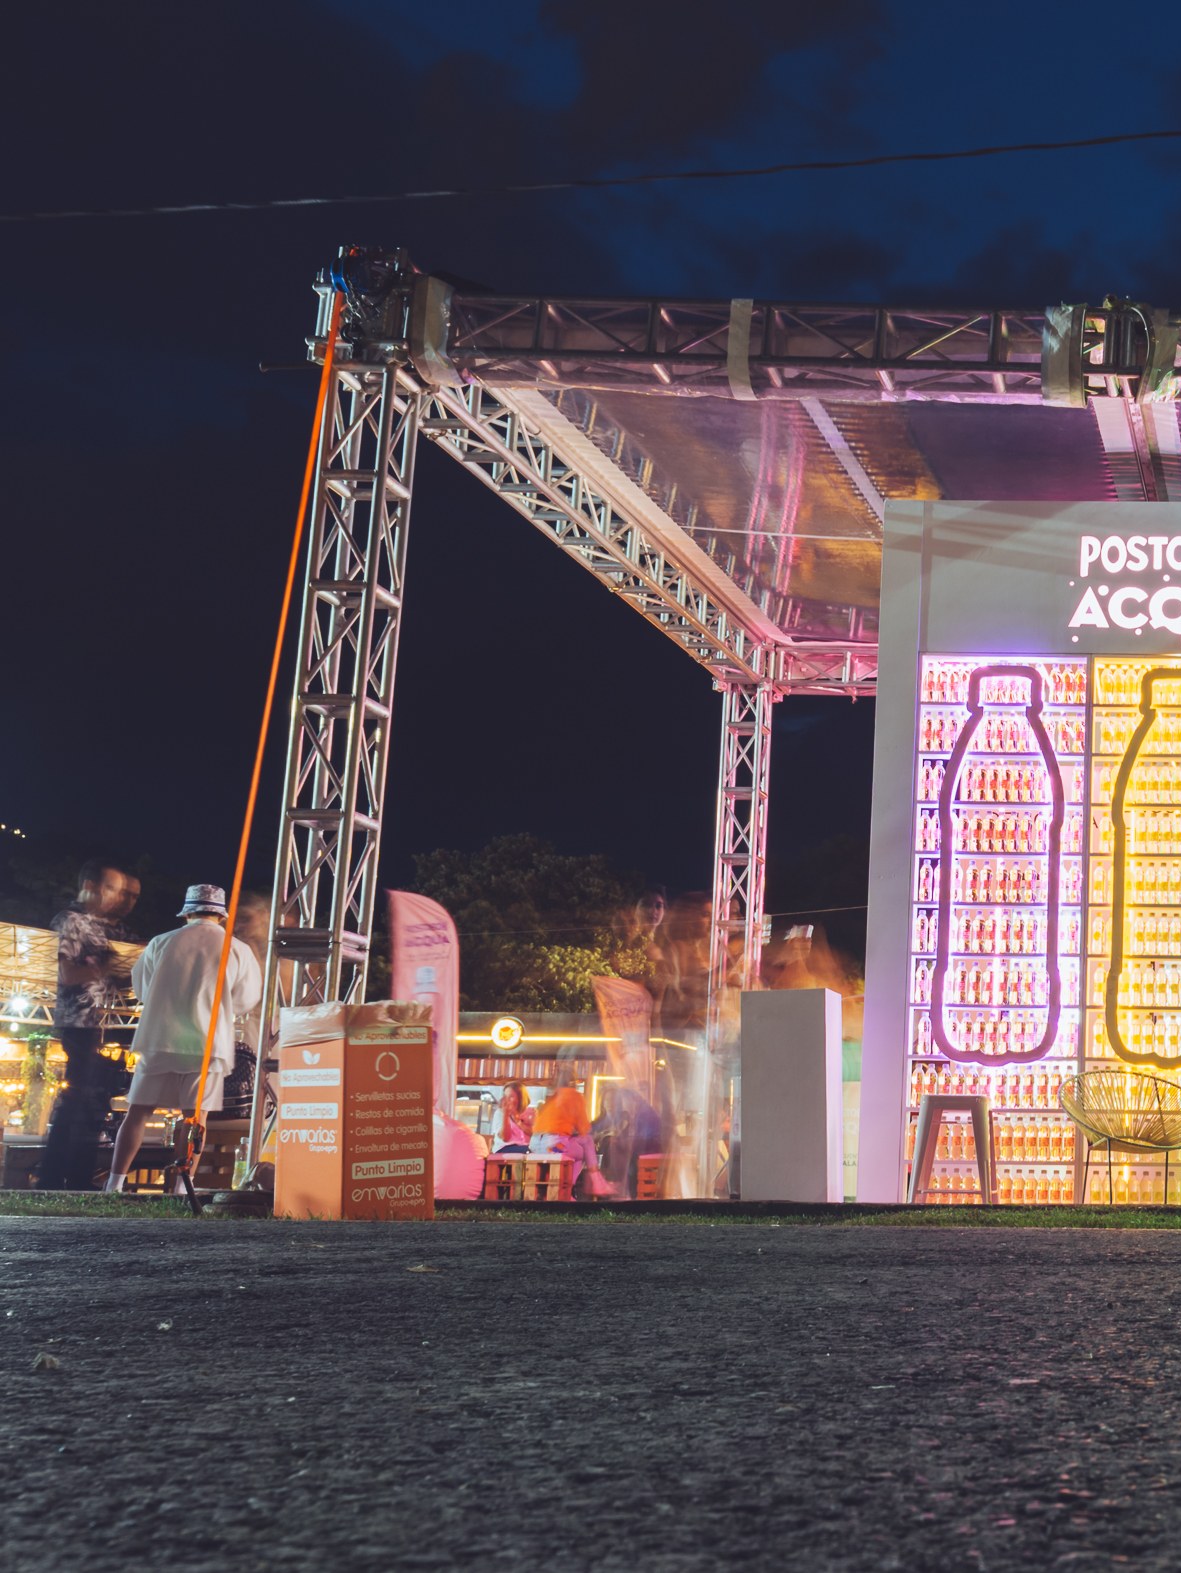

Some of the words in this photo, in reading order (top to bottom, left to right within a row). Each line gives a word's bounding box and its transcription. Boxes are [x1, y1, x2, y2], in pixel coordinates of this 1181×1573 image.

[355, 1091, 394, 1102] Servilletas
[396, 1090, 421, 1100] sucias
[286, 1106, 307, 1116] Punto
[310, 1105, 333, 1119] Limpio
[355, 1109, 381, 1119] Restos
[383, 1108, 393, 1117] de
[395, 1107, 424, 1116] comida
[355, 1125, 382, 1136] Colillas
[384, 1124, 394, 1134] de
[355, 1143, 389, 1153] Envoltura
[390, 1142, 400, 1151] de
[401, 1141, 428, 1150] mecato
[354, 1164, 385, 1176] Punto
[388, 1161, 422, 1175] Limpio
